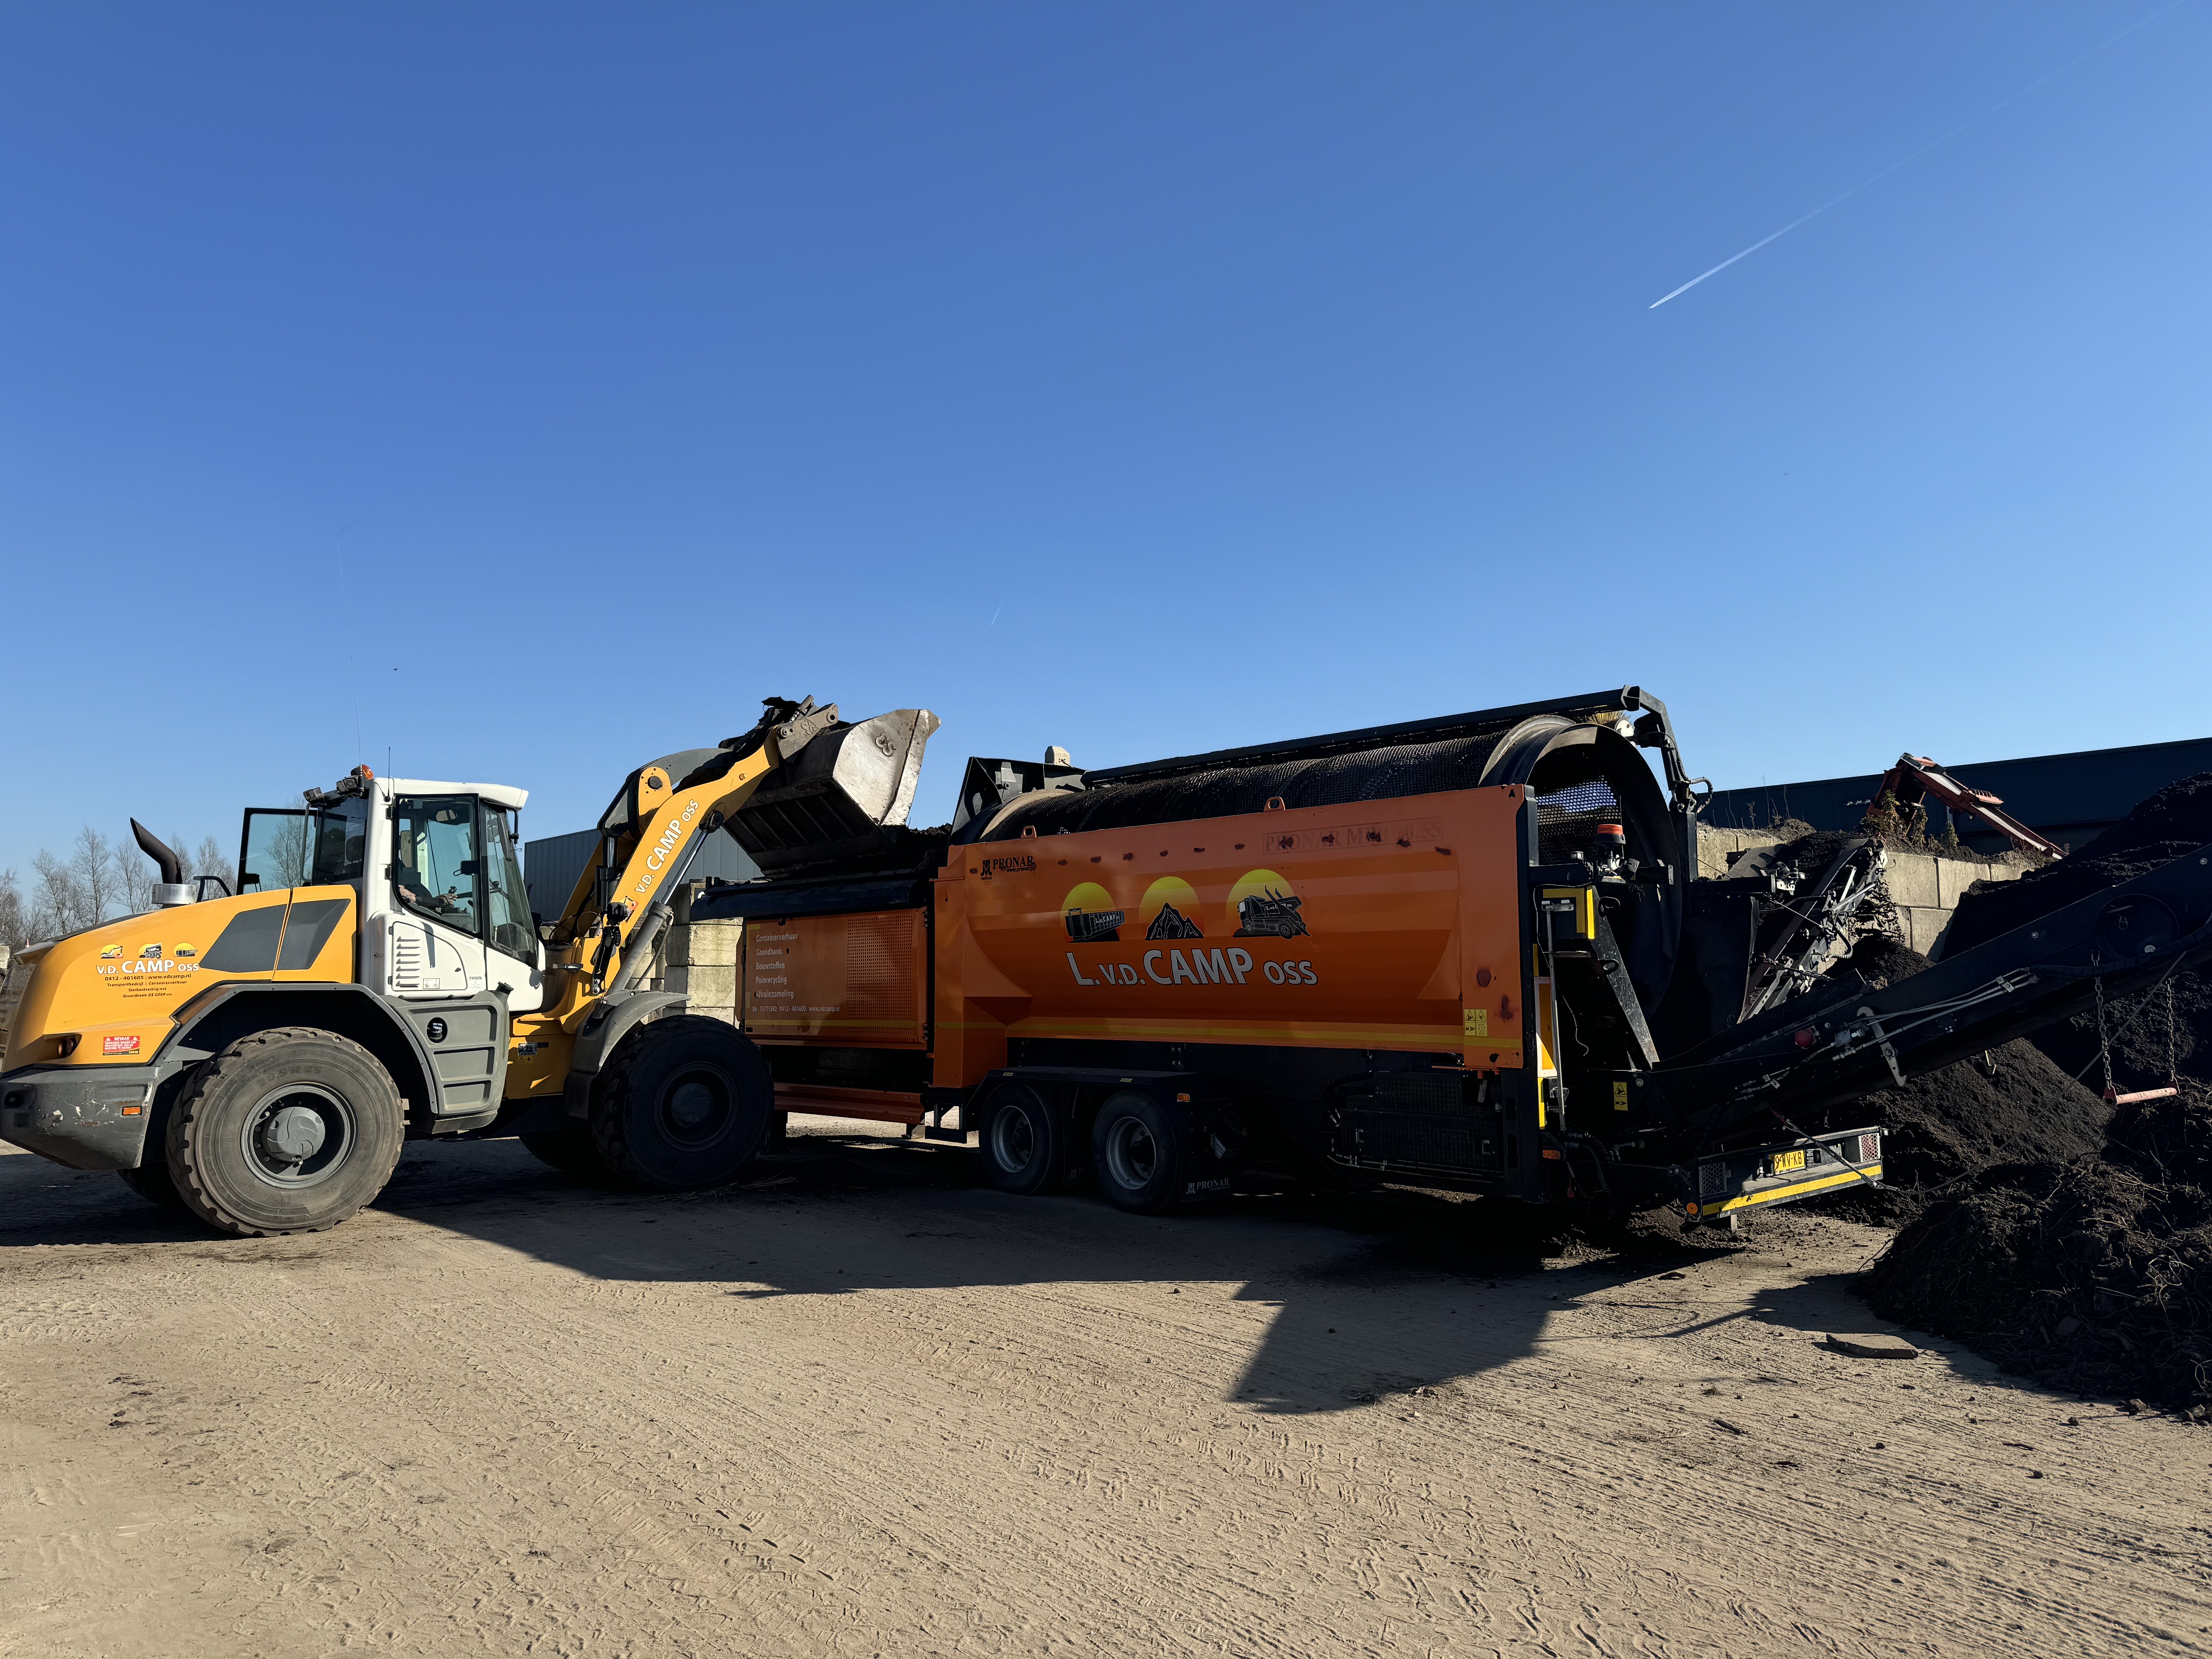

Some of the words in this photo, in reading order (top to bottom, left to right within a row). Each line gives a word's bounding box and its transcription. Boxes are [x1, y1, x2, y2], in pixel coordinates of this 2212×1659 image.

[646, 819, 683, 871] CAMP
[992, 855, 1035, 869] PRONAR
[756, 933, 798, 942] Containerverhuur
[756, 947, 782, 956] Grondbank
[96, 965, 119, 975] V.D.
[121, 959, 175, 973] CAMP
[756, 961, 785, 970] Bouwstoffen
[1143, 947, 1254, 985] CAMP
[756, 975, 787, 985] Puinrecycling
[756, 989, 794, 999] Afvalinzameling
[304, 1065, 323, 1074] 25
[1771, 1152, 1802, 1169] 9-WV-KB
[1196, 1178, 1230, 1190] PRONAR
